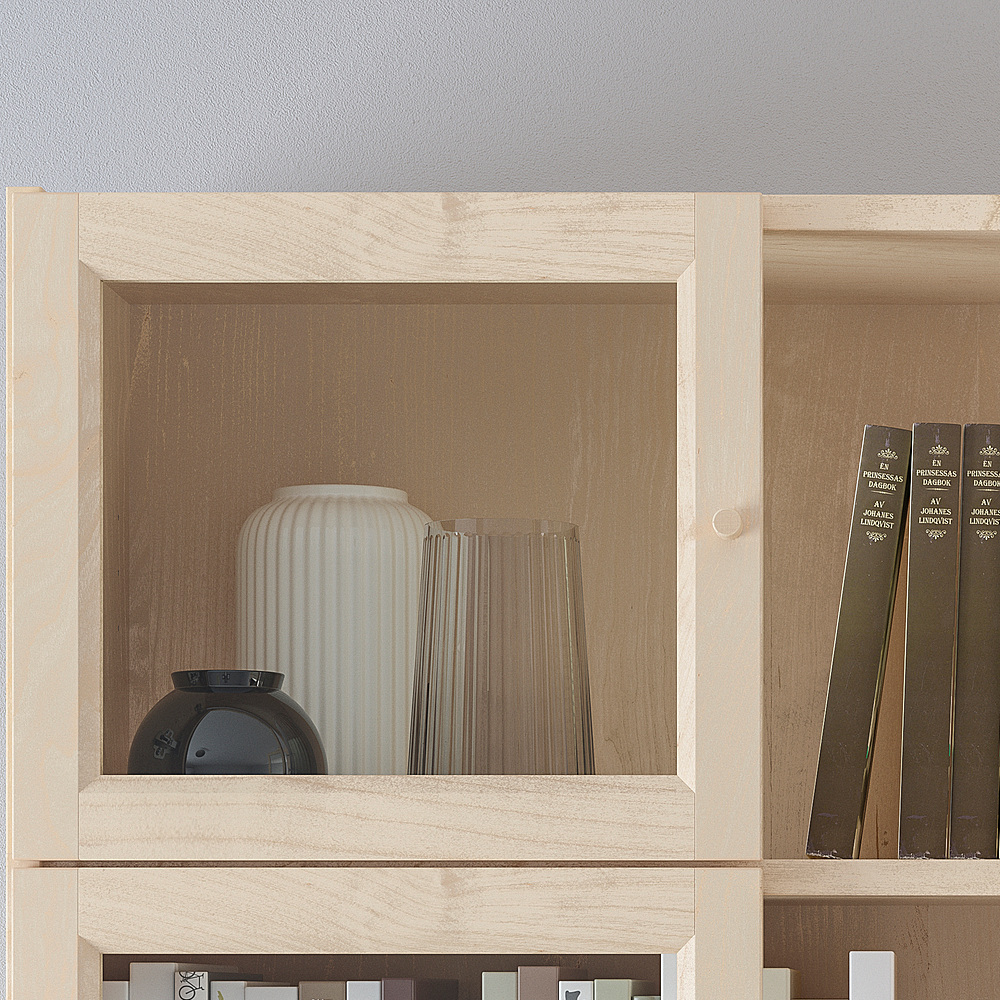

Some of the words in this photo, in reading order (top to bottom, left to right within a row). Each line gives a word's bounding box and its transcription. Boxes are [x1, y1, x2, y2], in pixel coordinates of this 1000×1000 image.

[863, 471, 903, 483] PRINSESSAS
[916, 470, 957, 478] PRINSESSAS
[868, 481, 897, 491] DAGBOK
[863, 511, 894, 519] JOHANES
[920, 507, 951, 515] JOHANES
